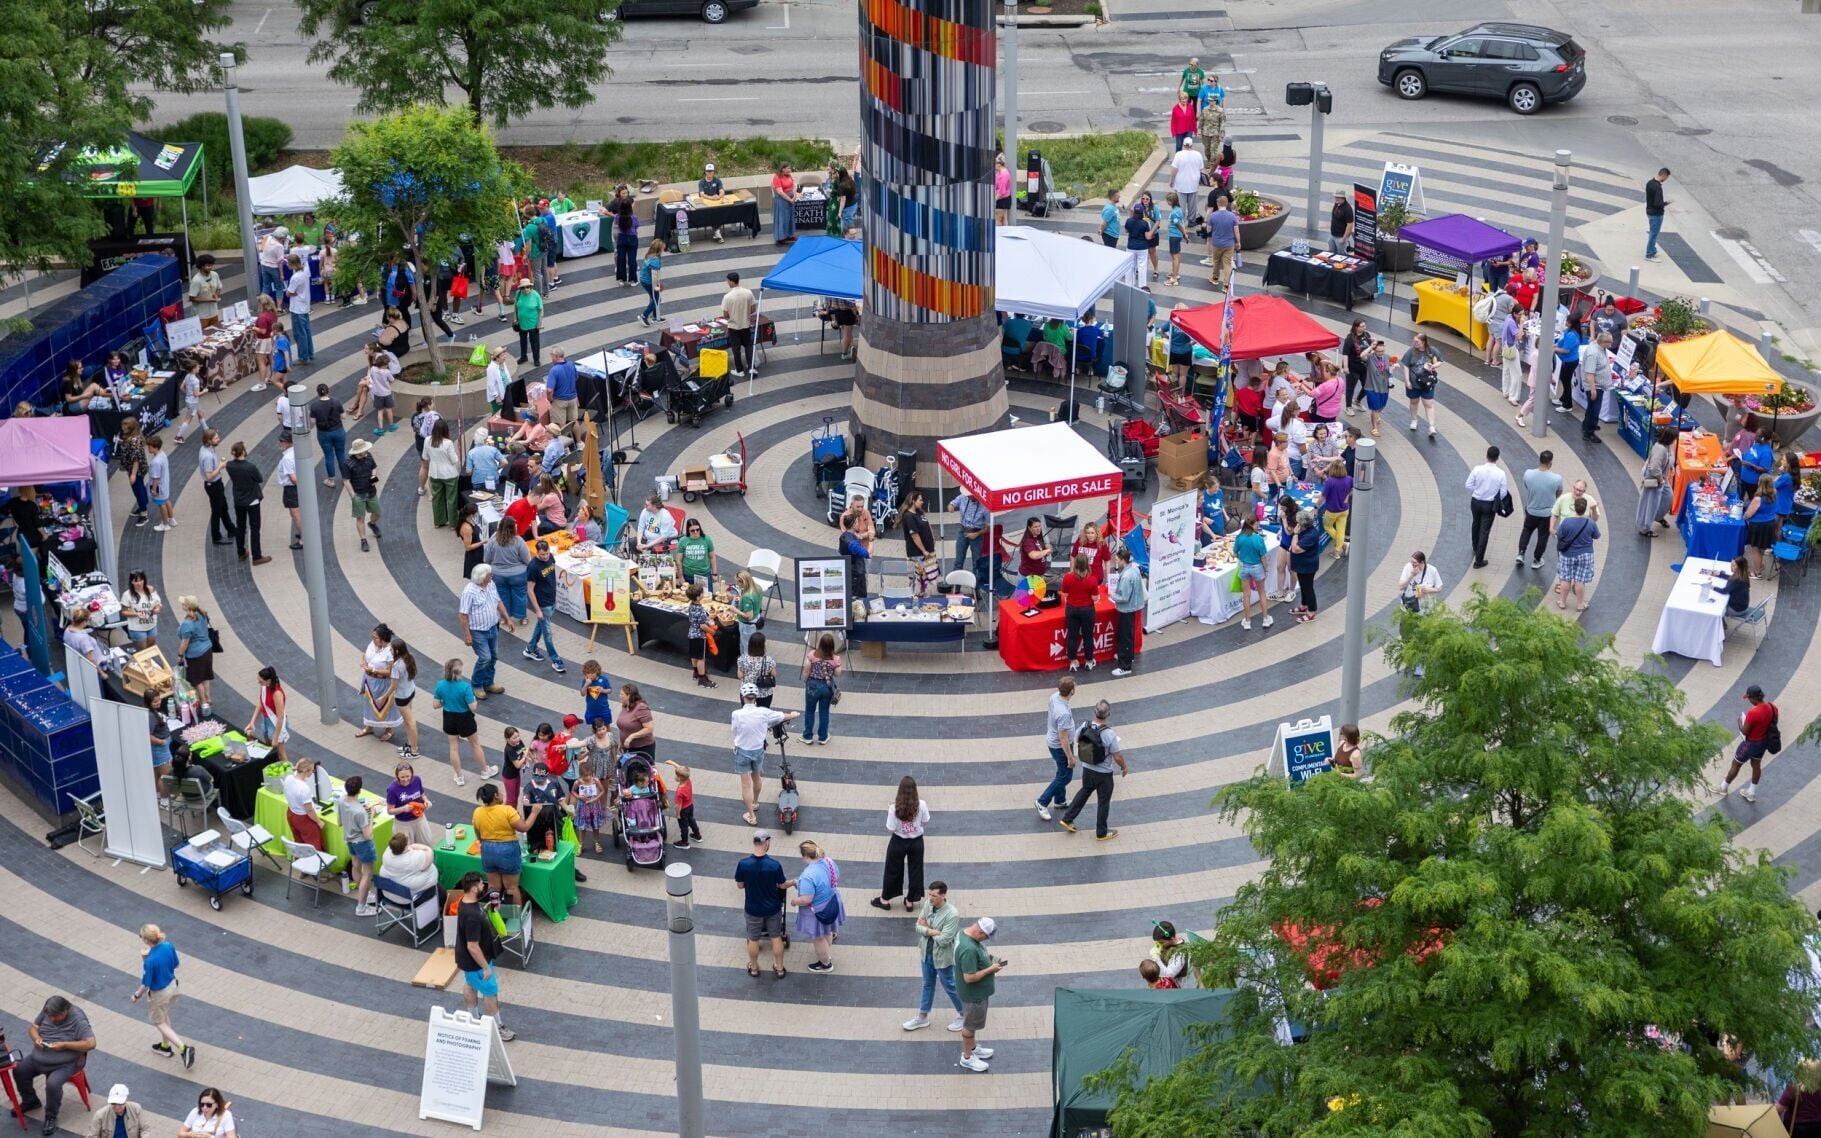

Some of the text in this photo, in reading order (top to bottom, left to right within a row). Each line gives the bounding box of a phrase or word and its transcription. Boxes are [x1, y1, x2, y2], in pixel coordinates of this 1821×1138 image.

[1384, 178, 1408, 192] give
[941, 452, 987, 501] NO GIRL FOR SALE
[1002, 478, 1112, 505] NO GIRL FOR SALE
[1054, 628, 1069, 641] I'V
[1293, 740, 1325, 764] give
[1291, 761, 1327, 772] COMPLIMENTA
